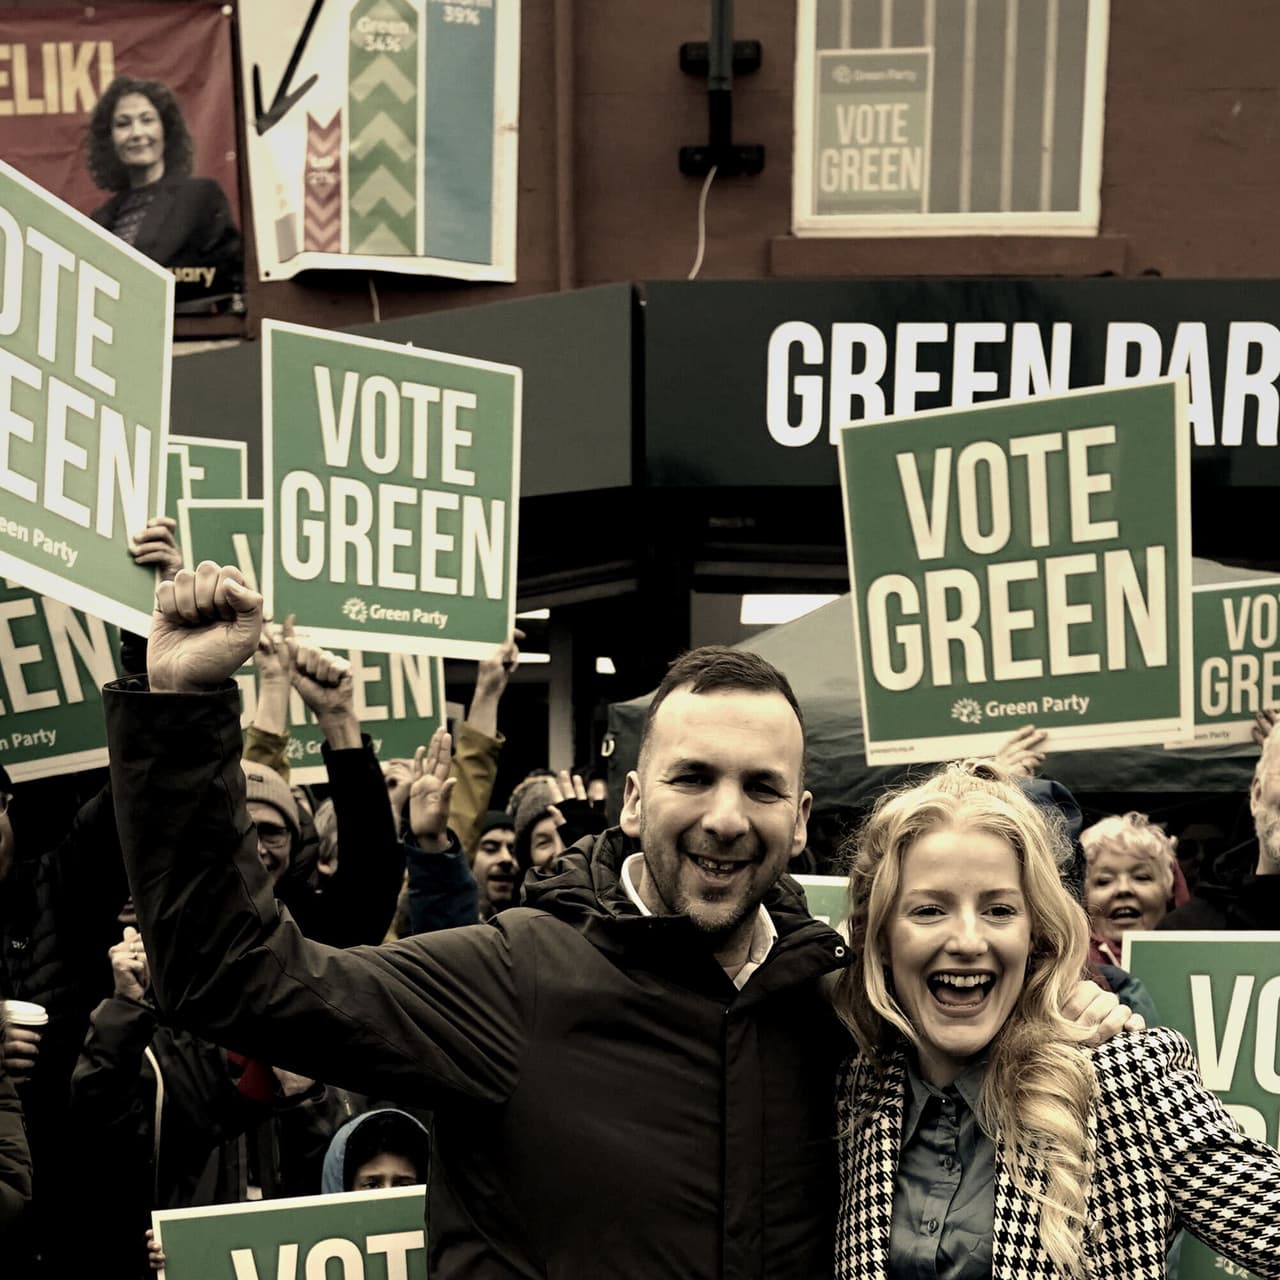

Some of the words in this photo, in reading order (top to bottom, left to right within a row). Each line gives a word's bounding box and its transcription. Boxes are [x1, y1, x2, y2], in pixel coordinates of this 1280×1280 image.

[357, 17, 410, 34] Green
[836, 103, 909, 145] VOTE
[821, 147, 921, 192] GREEN
[767, 321, 1072, 447] GREEN
[315, 366, 477, 486] VOTE
[897, 425, 1118, 561] VOTE
[31, 528, 78, 568] Party
[280, 470, 505, 600] GREEN
[370, 604, 410, 623] Green
[412, 608, 448, 630] Party
[867, 546, 1168, 691] GREEN
[986, 698, 1038, 719] Green
[1041, 694, 1090, 718] Party
[12, 728, 56, 749] Party
